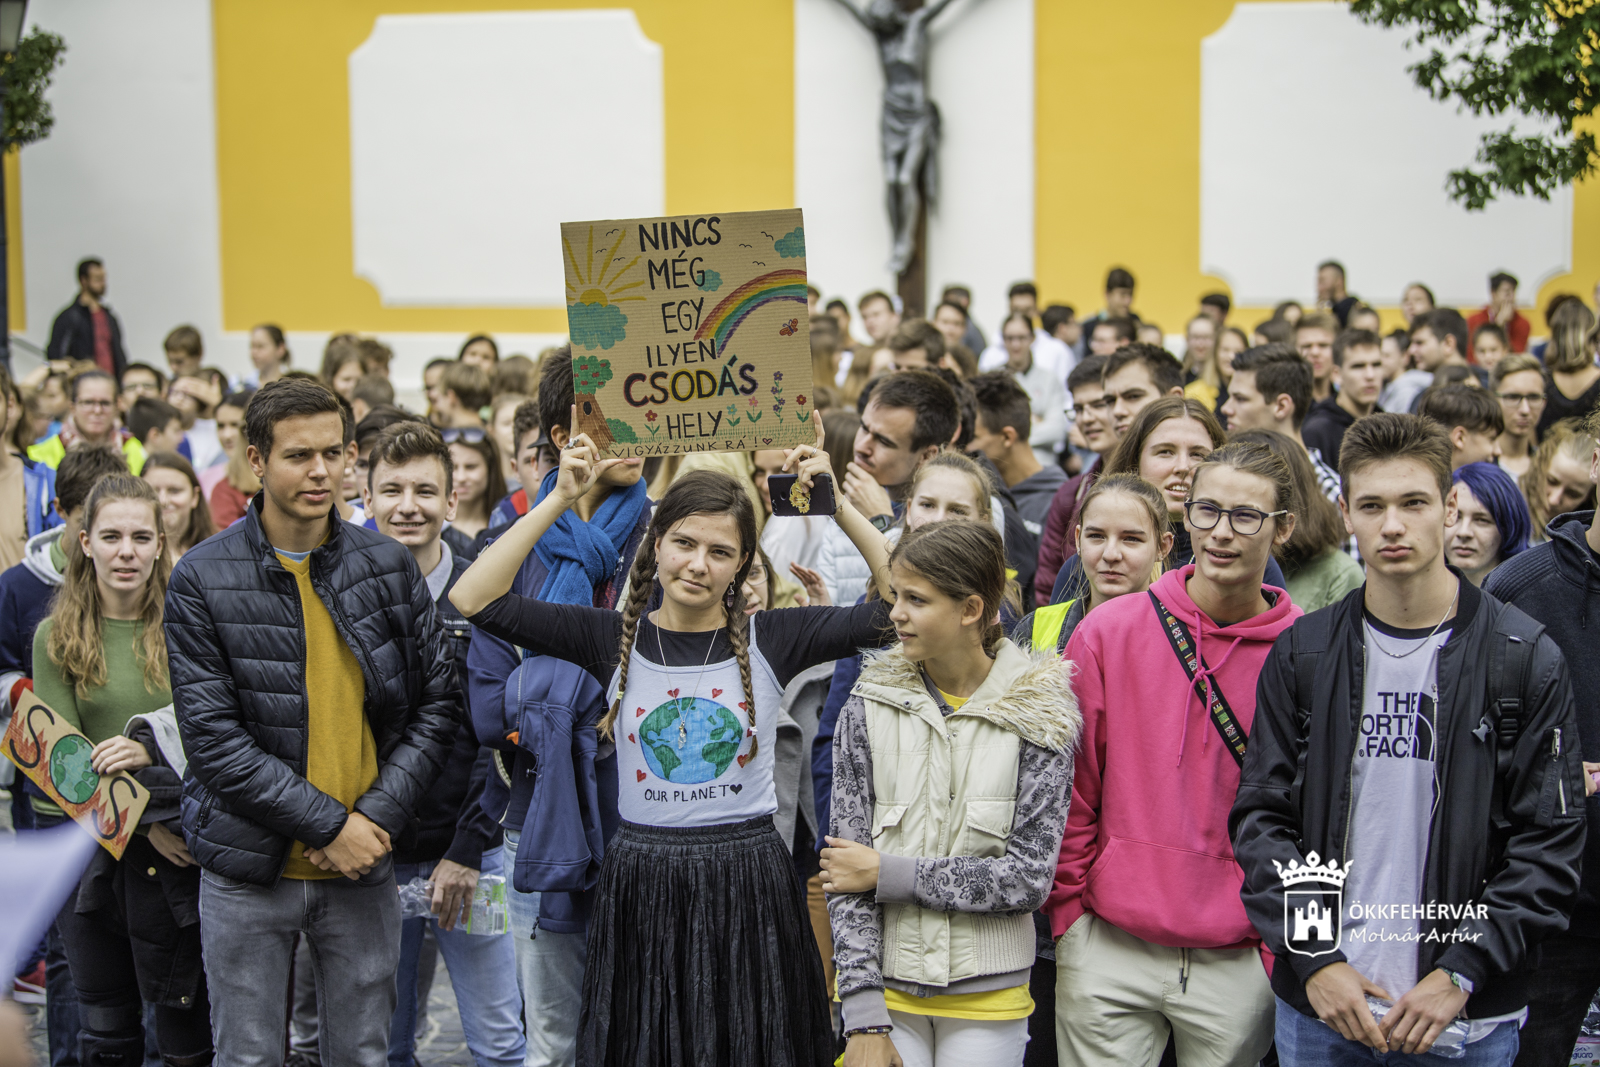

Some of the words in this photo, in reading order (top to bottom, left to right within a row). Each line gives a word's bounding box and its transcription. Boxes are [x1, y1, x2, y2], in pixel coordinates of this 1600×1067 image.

[638, 216, 721, 252] NINCS
[647, 250, 706, 291] MÉG
[661, 297, 704, 334] EGY
[646, 338, 717, 368] ILYEN
[624, 354, 758, 408] CSODÁS
[666, 410, 722, 440] HELY
[611, 441, 717, 458] VIGYÁZZUNK
[1377, 692, 1418, 714] THE
[1360, 714, 1414, 736] ORTH
[644, 788, 668, 802] OUR
[673, 784, 729, 802] PLANET
[1572, 1052, 1593, 1060] guaro
